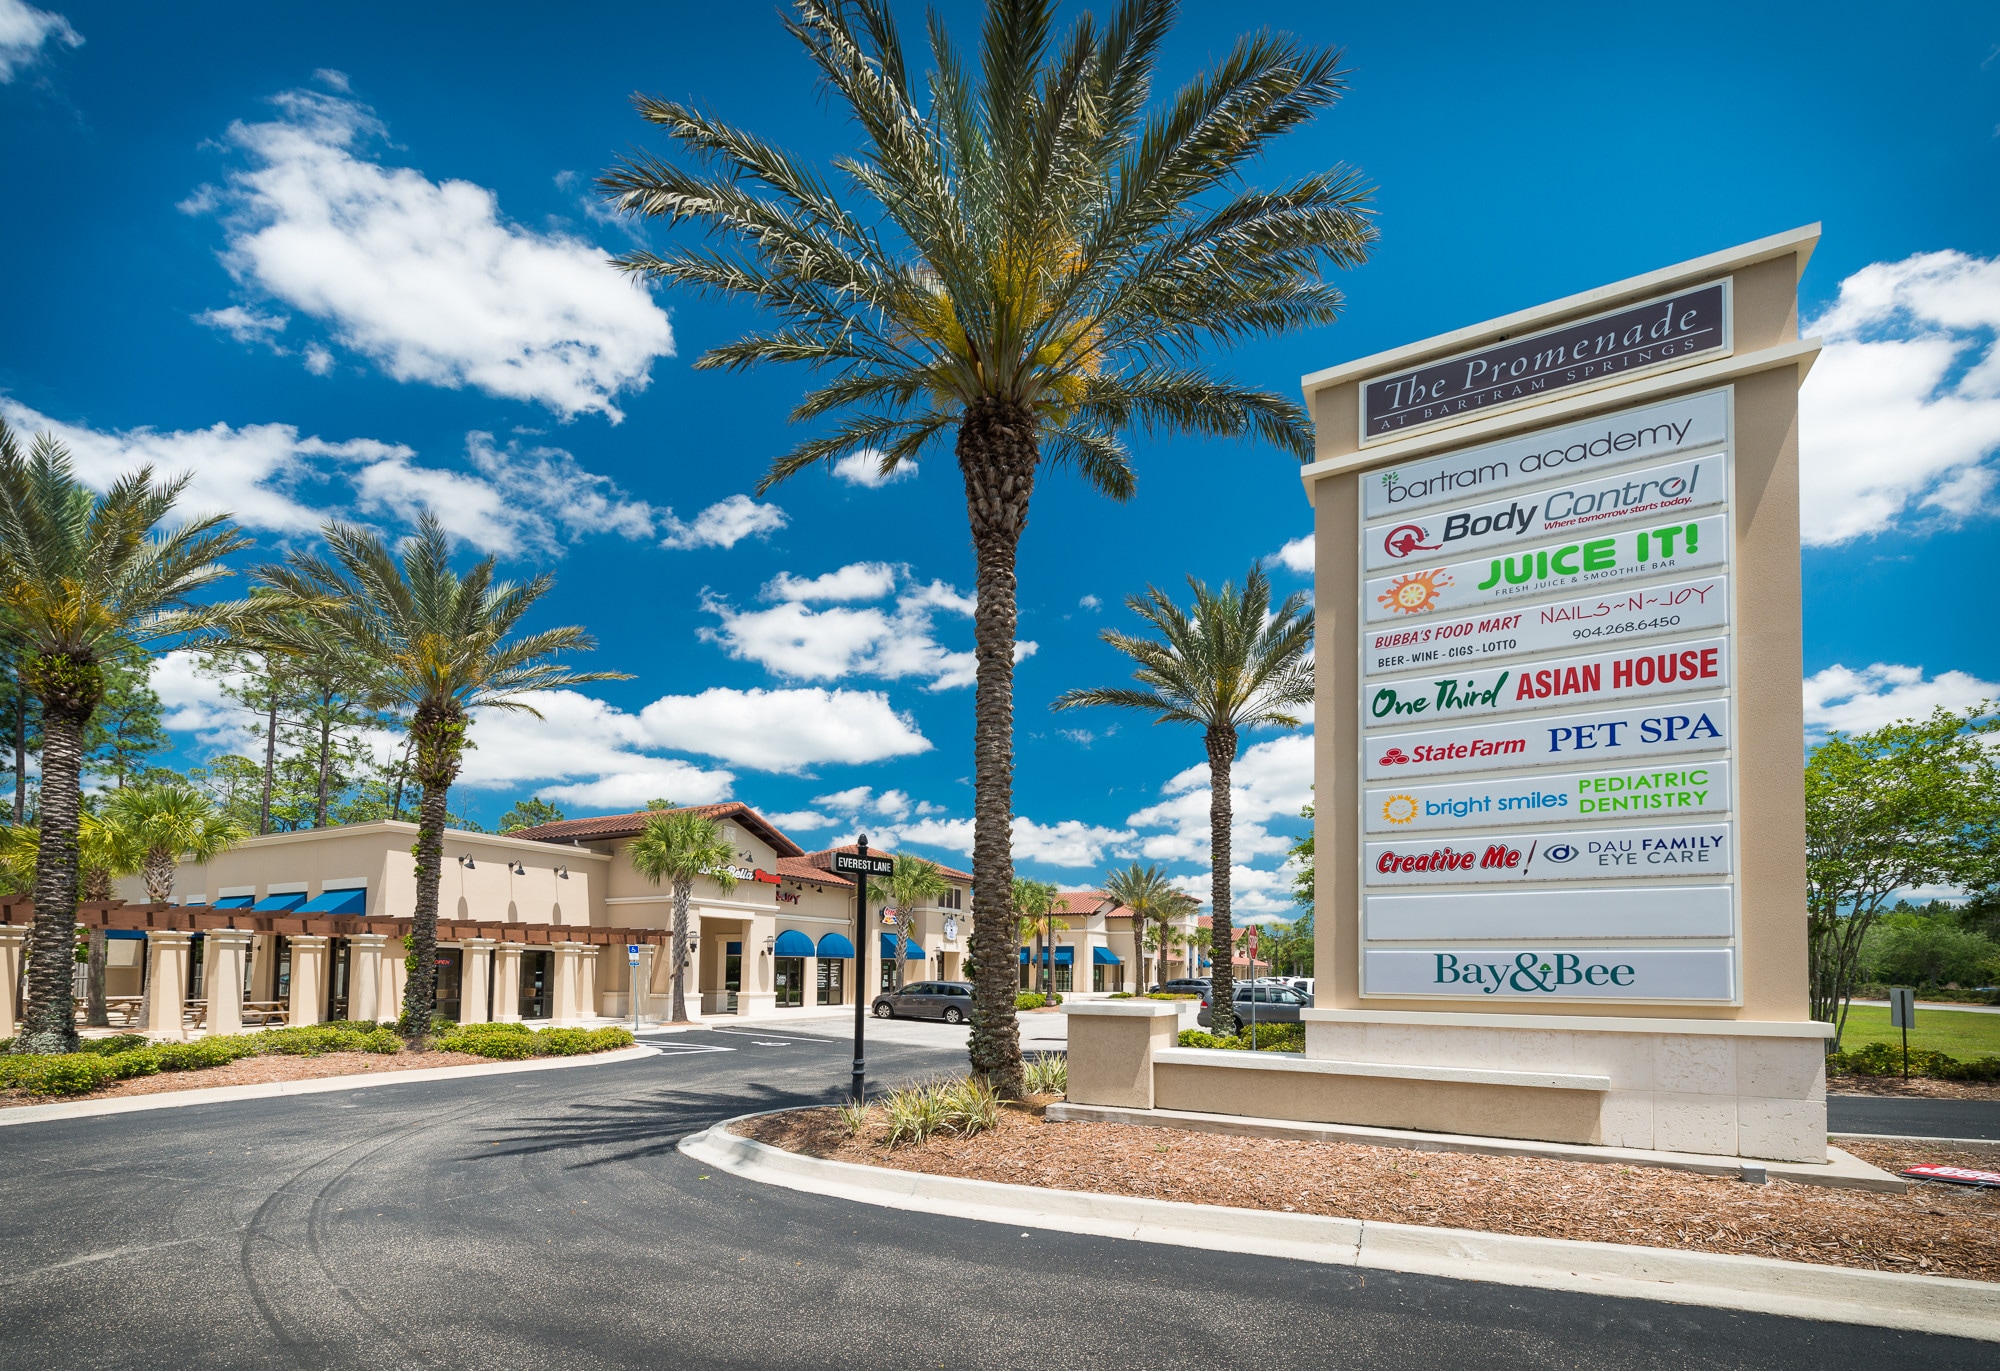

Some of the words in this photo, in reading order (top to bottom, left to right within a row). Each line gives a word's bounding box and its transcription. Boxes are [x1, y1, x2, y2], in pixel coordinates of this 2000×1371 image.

[1384, 374, 1446, 410] The
[1461, 302, 1698, 391] Promenade
[1381, 415, 1407, 430] AT
[1424, 378, 1545, 419] BARTRAM
[1566, 339, 1695, 381] SPRINGS
[1387, 461, 1509, 504] bartram
[1519, 418, 1693, 473] academy
[1442, 502, 1539, 543] Body
[1544, 463, 1700, 521] Control
[1544, 517, 1577, 531] Where
[1577, 508, 1629, 525] tomorrow
[1629, 502, 1659, 514] starts
[1660, 496, 1693, 509] today.
[1477, 538, 1617, 591] JUICE
[1636, 523, 1699, 563] IT!
[1495, 584, 1530, 597] FRESH
[1534, 578, 1566, 590] JUICE
[1583, 564, 1646, 581] SMOOTHIE
[1652, 559, 1676, 570] BAR
[1374, 629, 1432, 649] BUBBA'S
[1434, 622, 1474, 641] FOOD
[1477, 614, 1522, 634] MART
[1572, 614, 1681, 640] 904.268.6450
[1448, 645, 1474, 658] CIGS
[1482, 639, 1517, 653] LOTTO
[1515, 663, 1601, 701] ASIAN
[1612, 647, 1719, 689] HOUSE
[1371, 687, 1431, 718] One
[1434, 671, 1510, 712] Third
[1547, 720, 1628, 753] PET
[1639, 712, 1723, 744] SPA
[1578, 769, 1709, 794] PEDIATRIC
[1425, 794, 1491, 818] bright
[1497, 791, 1569, 812] smiles
[1578, 790, 1709, 814] DENTISTRY
[1375, 847, 1476, 874] Creative
[1588, 839, 1632, 853] DAU
[1642, 835, 1724, 850] FAMILY
[1598, 853, 1638, 865] EYE
[1646, 850, 1709, 864] CARE
[838, 856, 872, 870] EVEREST
[873, 860, 891, 873] LANE
